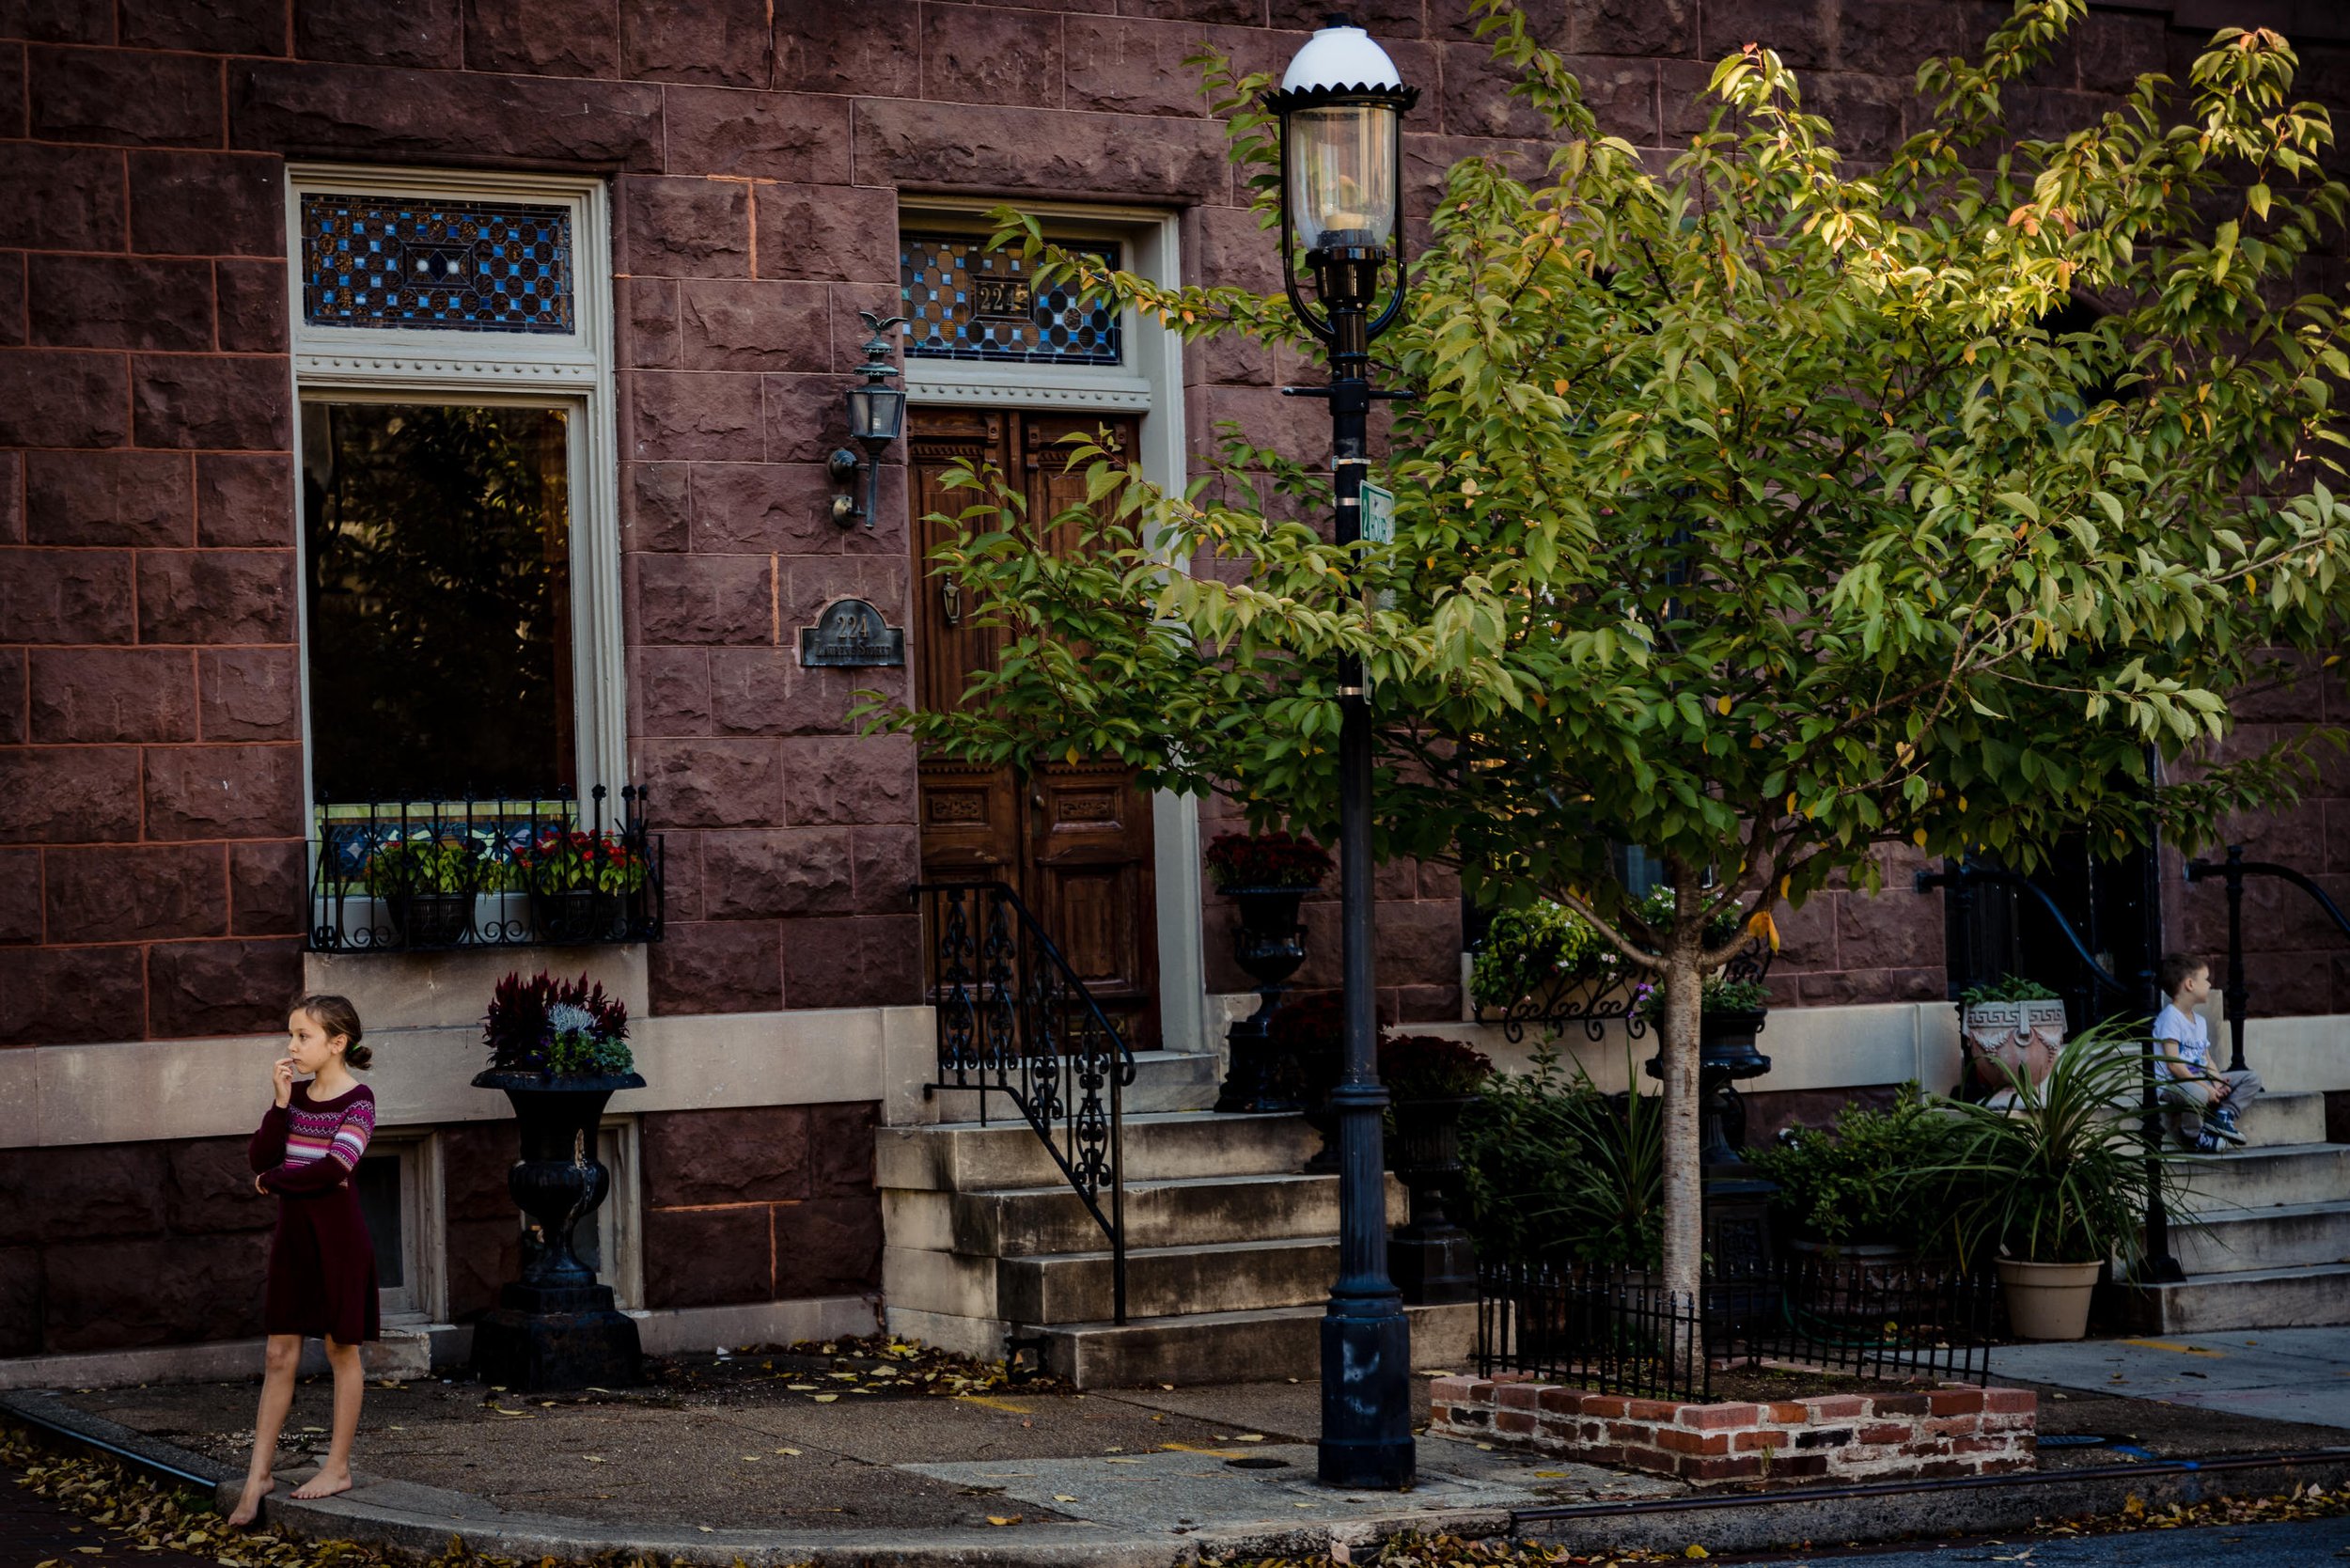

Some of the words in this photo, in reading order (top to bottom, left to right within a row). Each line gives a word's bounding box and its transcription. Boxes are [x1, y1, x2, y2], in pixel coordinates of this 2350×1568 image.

[980, 287, 1016, 311] 224
[1362, 498, 1370, 539] 2
[836, 614, 870, 639] 224
